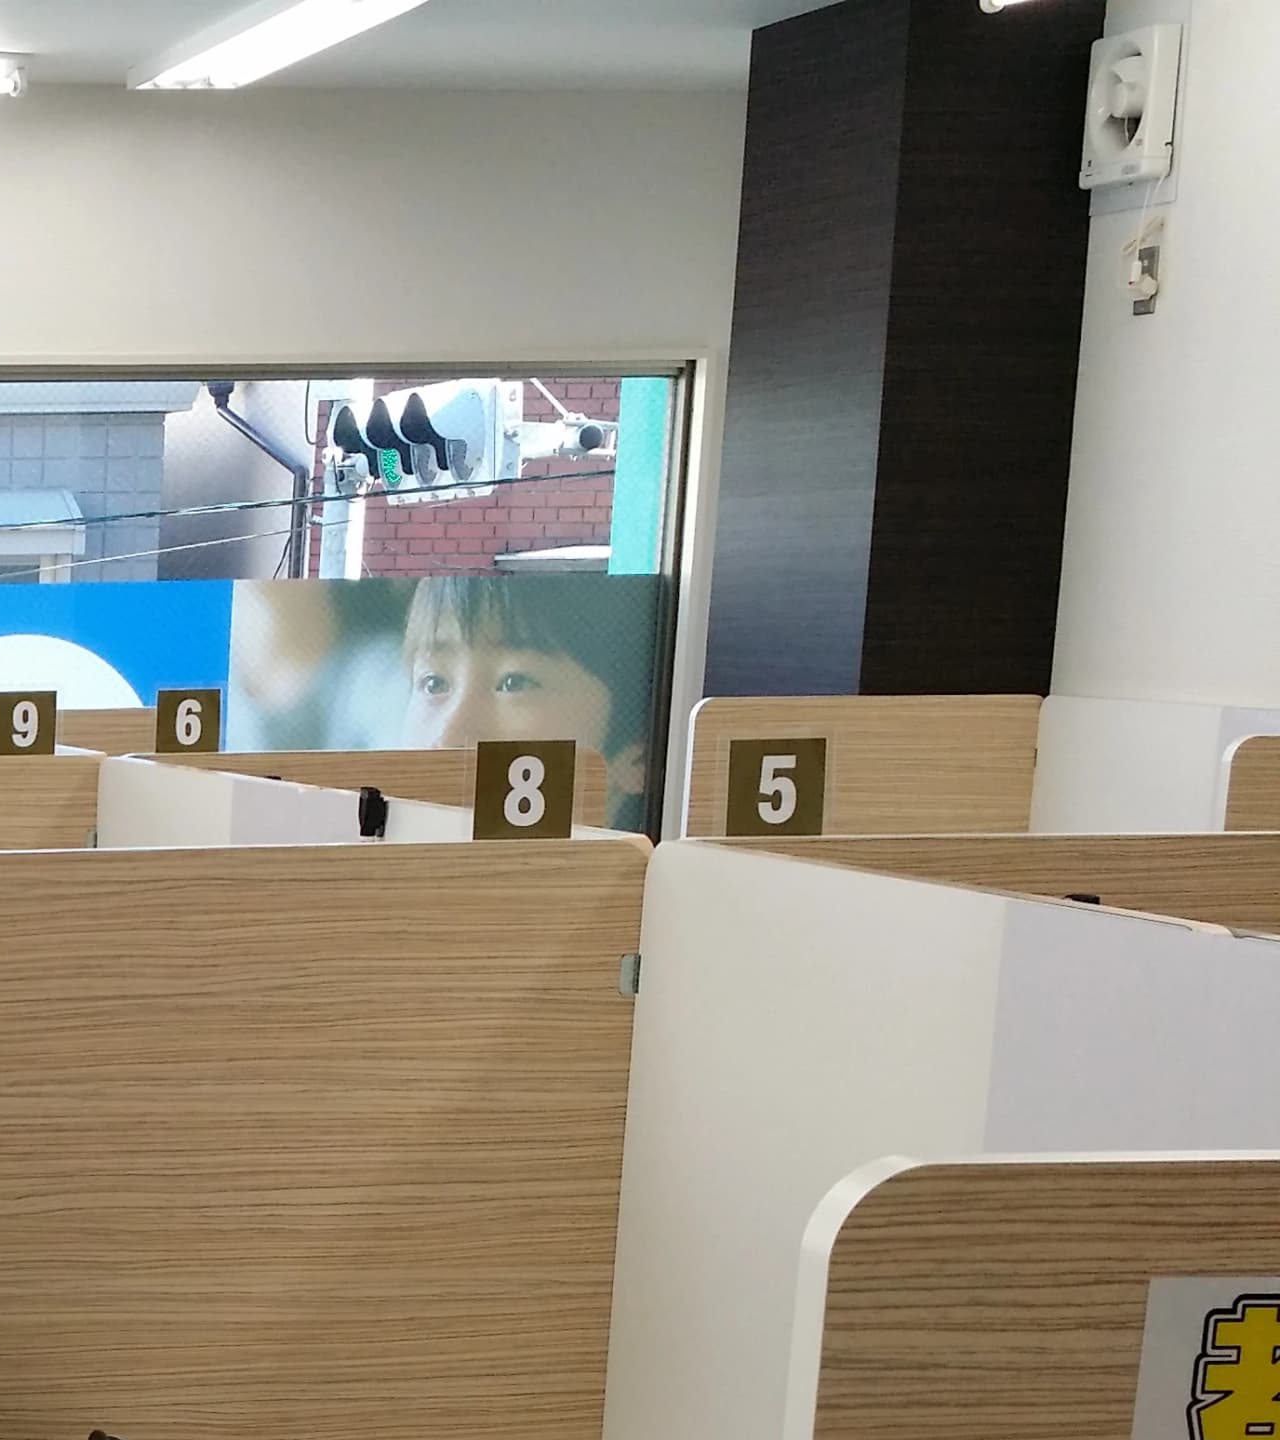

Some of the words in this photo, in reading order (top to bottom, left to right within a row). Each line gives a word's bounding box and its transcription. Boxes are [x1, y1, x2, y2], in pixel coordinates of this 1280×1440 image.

[11, 700, 39, 748] 9
[174, 698, 203, 746] 6
[503, 754, 546, 828] 8
[757, 754, 797, 825] 5
